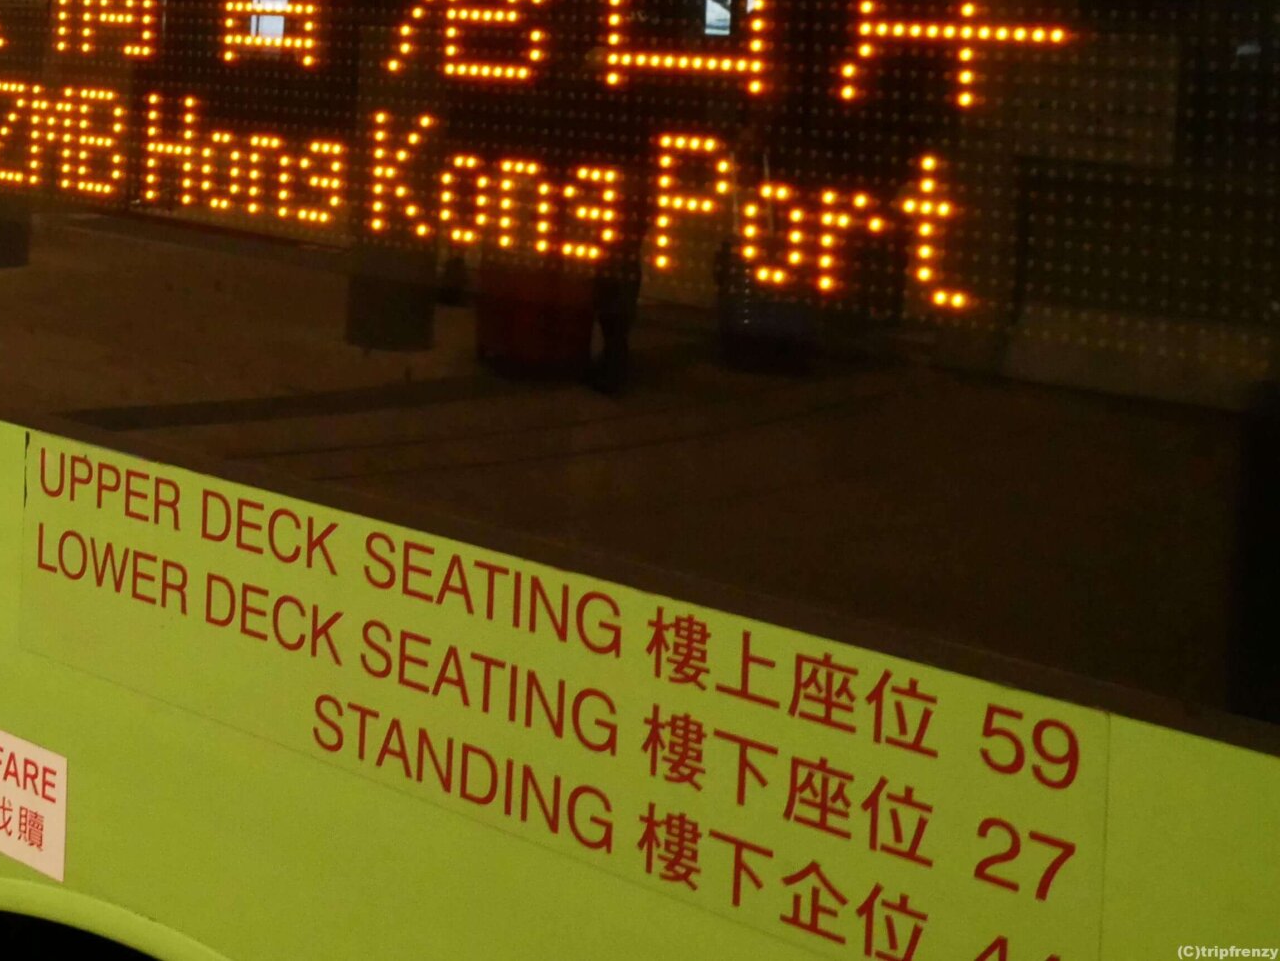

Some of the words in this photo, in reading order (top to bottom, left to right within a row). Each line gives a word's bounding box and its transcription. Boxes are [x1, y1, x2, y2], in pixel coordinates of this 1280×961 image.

[145, 93, 343, 224] Hong
[370, 111, 619, 258] Kong
[655, 133, 969, 309] Port
[36, 522, 188, 616] LOWER
[205, 572, 344, 667] DECK
[360, 619, 619, 757] SEATING
[640, 703, 934, 868] 樓下座位
[973, 816, 1077, 901] 27
[40, 447, 181, 531] UPPER
[201, 489, 339, 576] DECK
[363, 531, 623, 659] SEATING
[645, 605, 939, 759] 樓上座位
[979, 702, 1081, 791] 59
[312, 694, 615, 854] STANDING
[636, 802, 929, 961] 樓下企位
